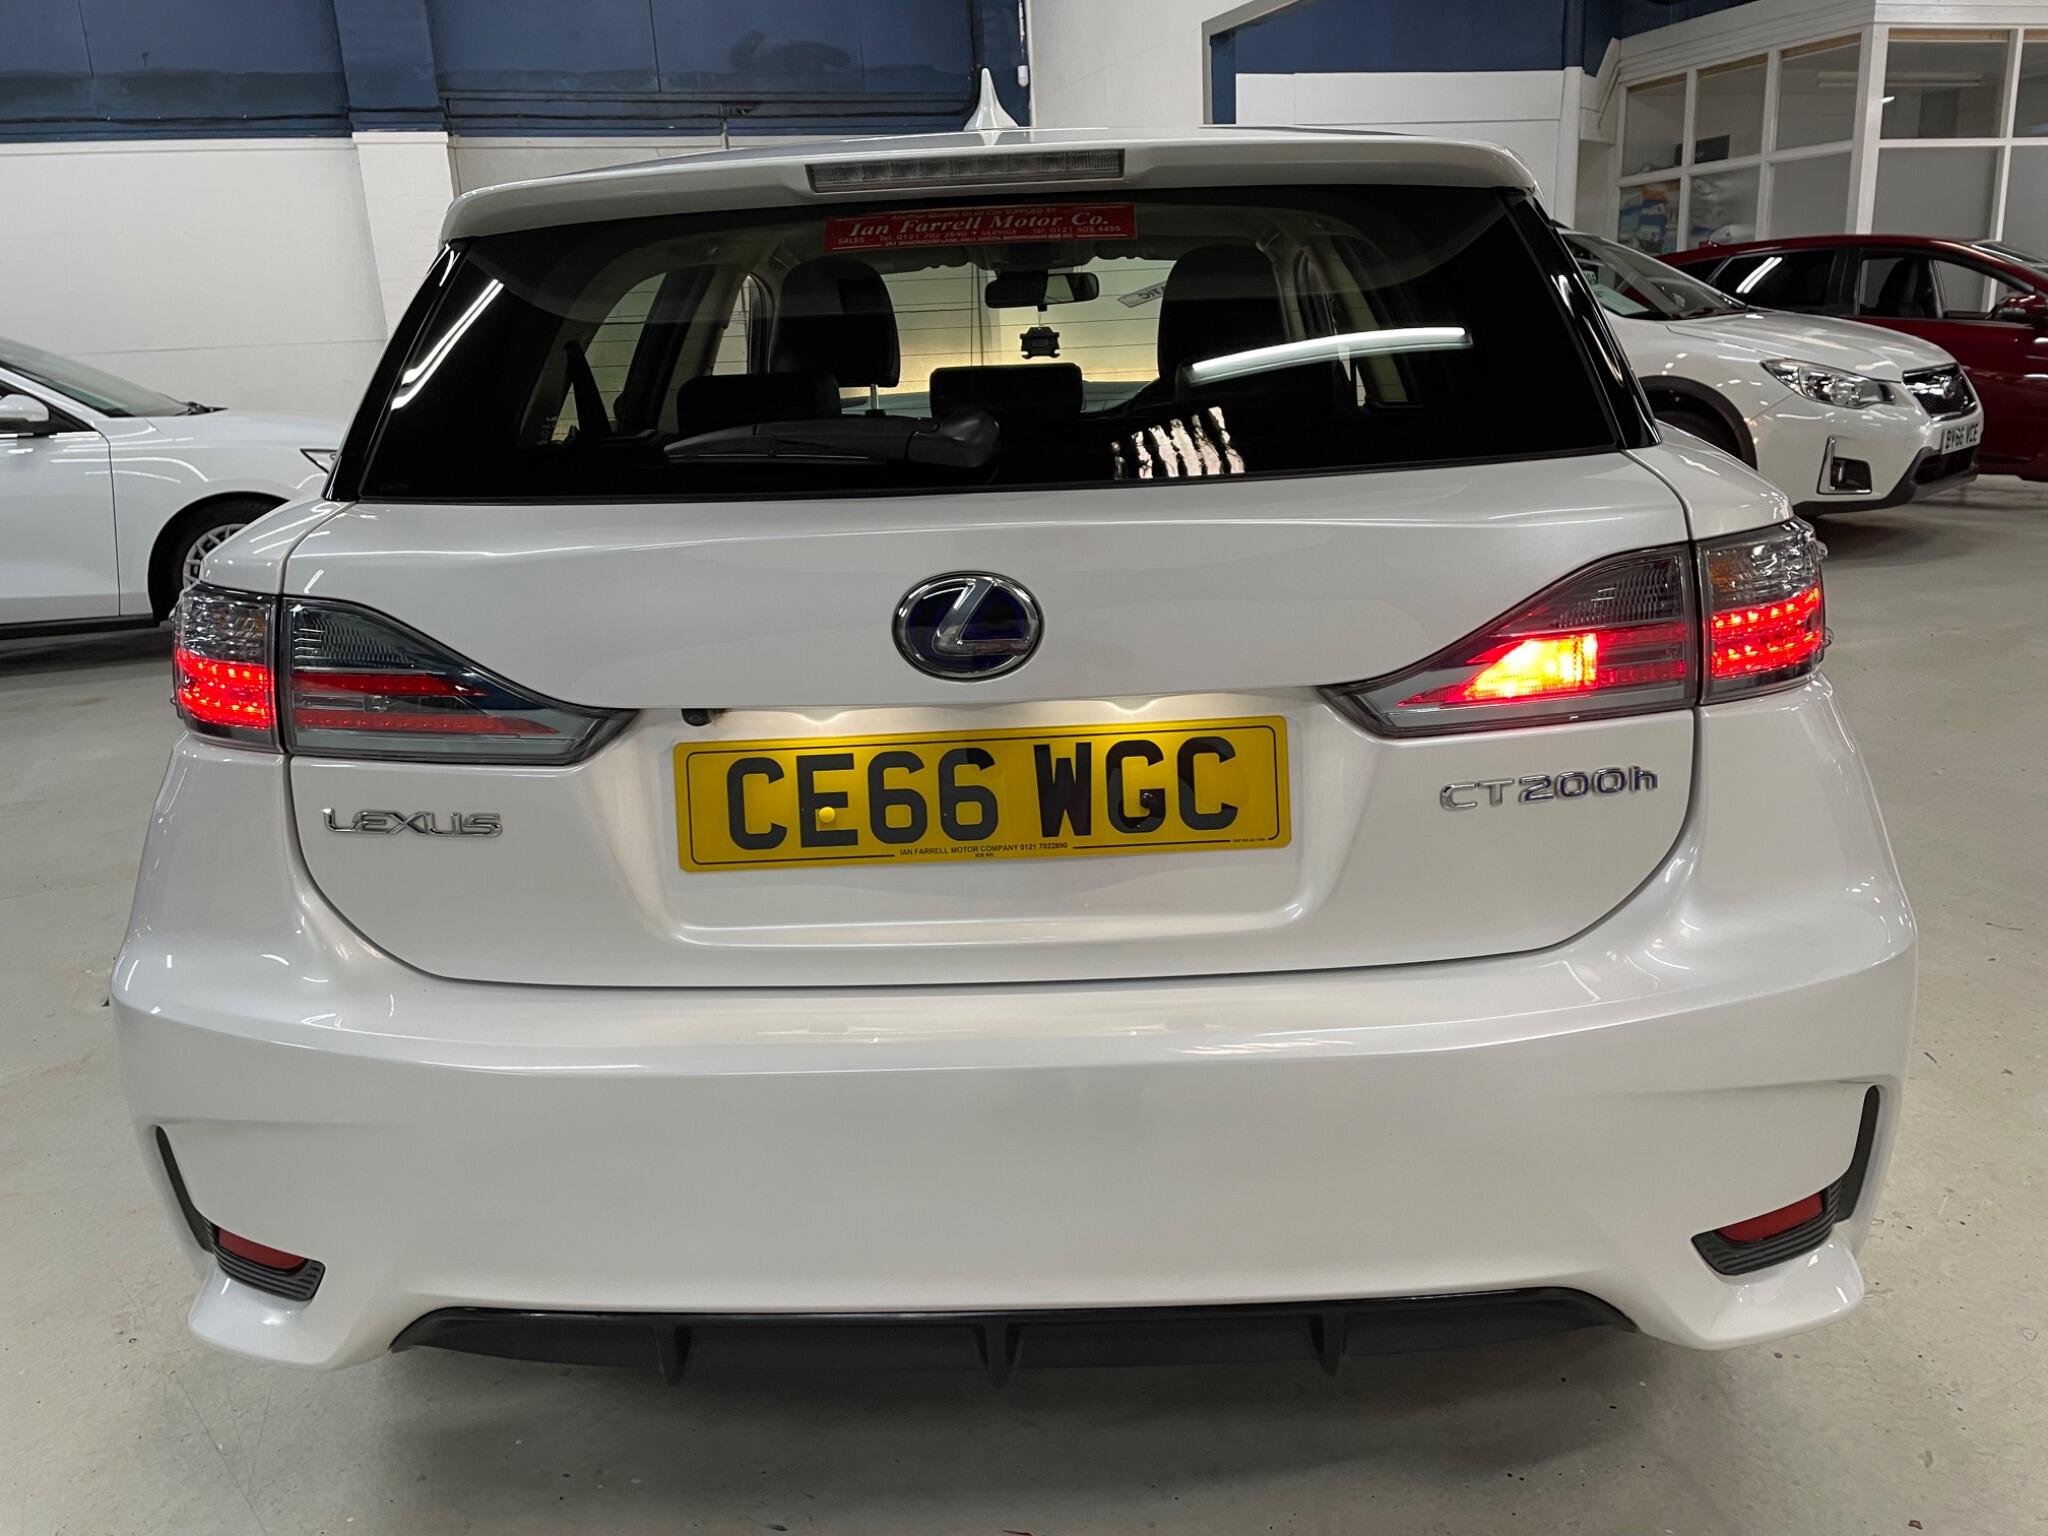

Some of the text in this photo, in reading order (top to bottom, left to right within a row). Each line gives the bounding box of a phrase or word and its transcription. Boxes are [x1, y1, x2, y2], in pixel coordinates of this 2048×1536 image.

[849, 212, 1109, 237] Ian Farrell Motor Co.
[838, 237, 865, 245] SALES
[896, 233, 919, 241] 0121
[726, 736, 1239, 851] CE66 WGC
[1440, 765, 1658, 811] CT200h
[321, 808, 503, 837] LEXUS
[951, 846, 977, 854] MOTOR
[980, 844, 1018, 852] COMPANY
